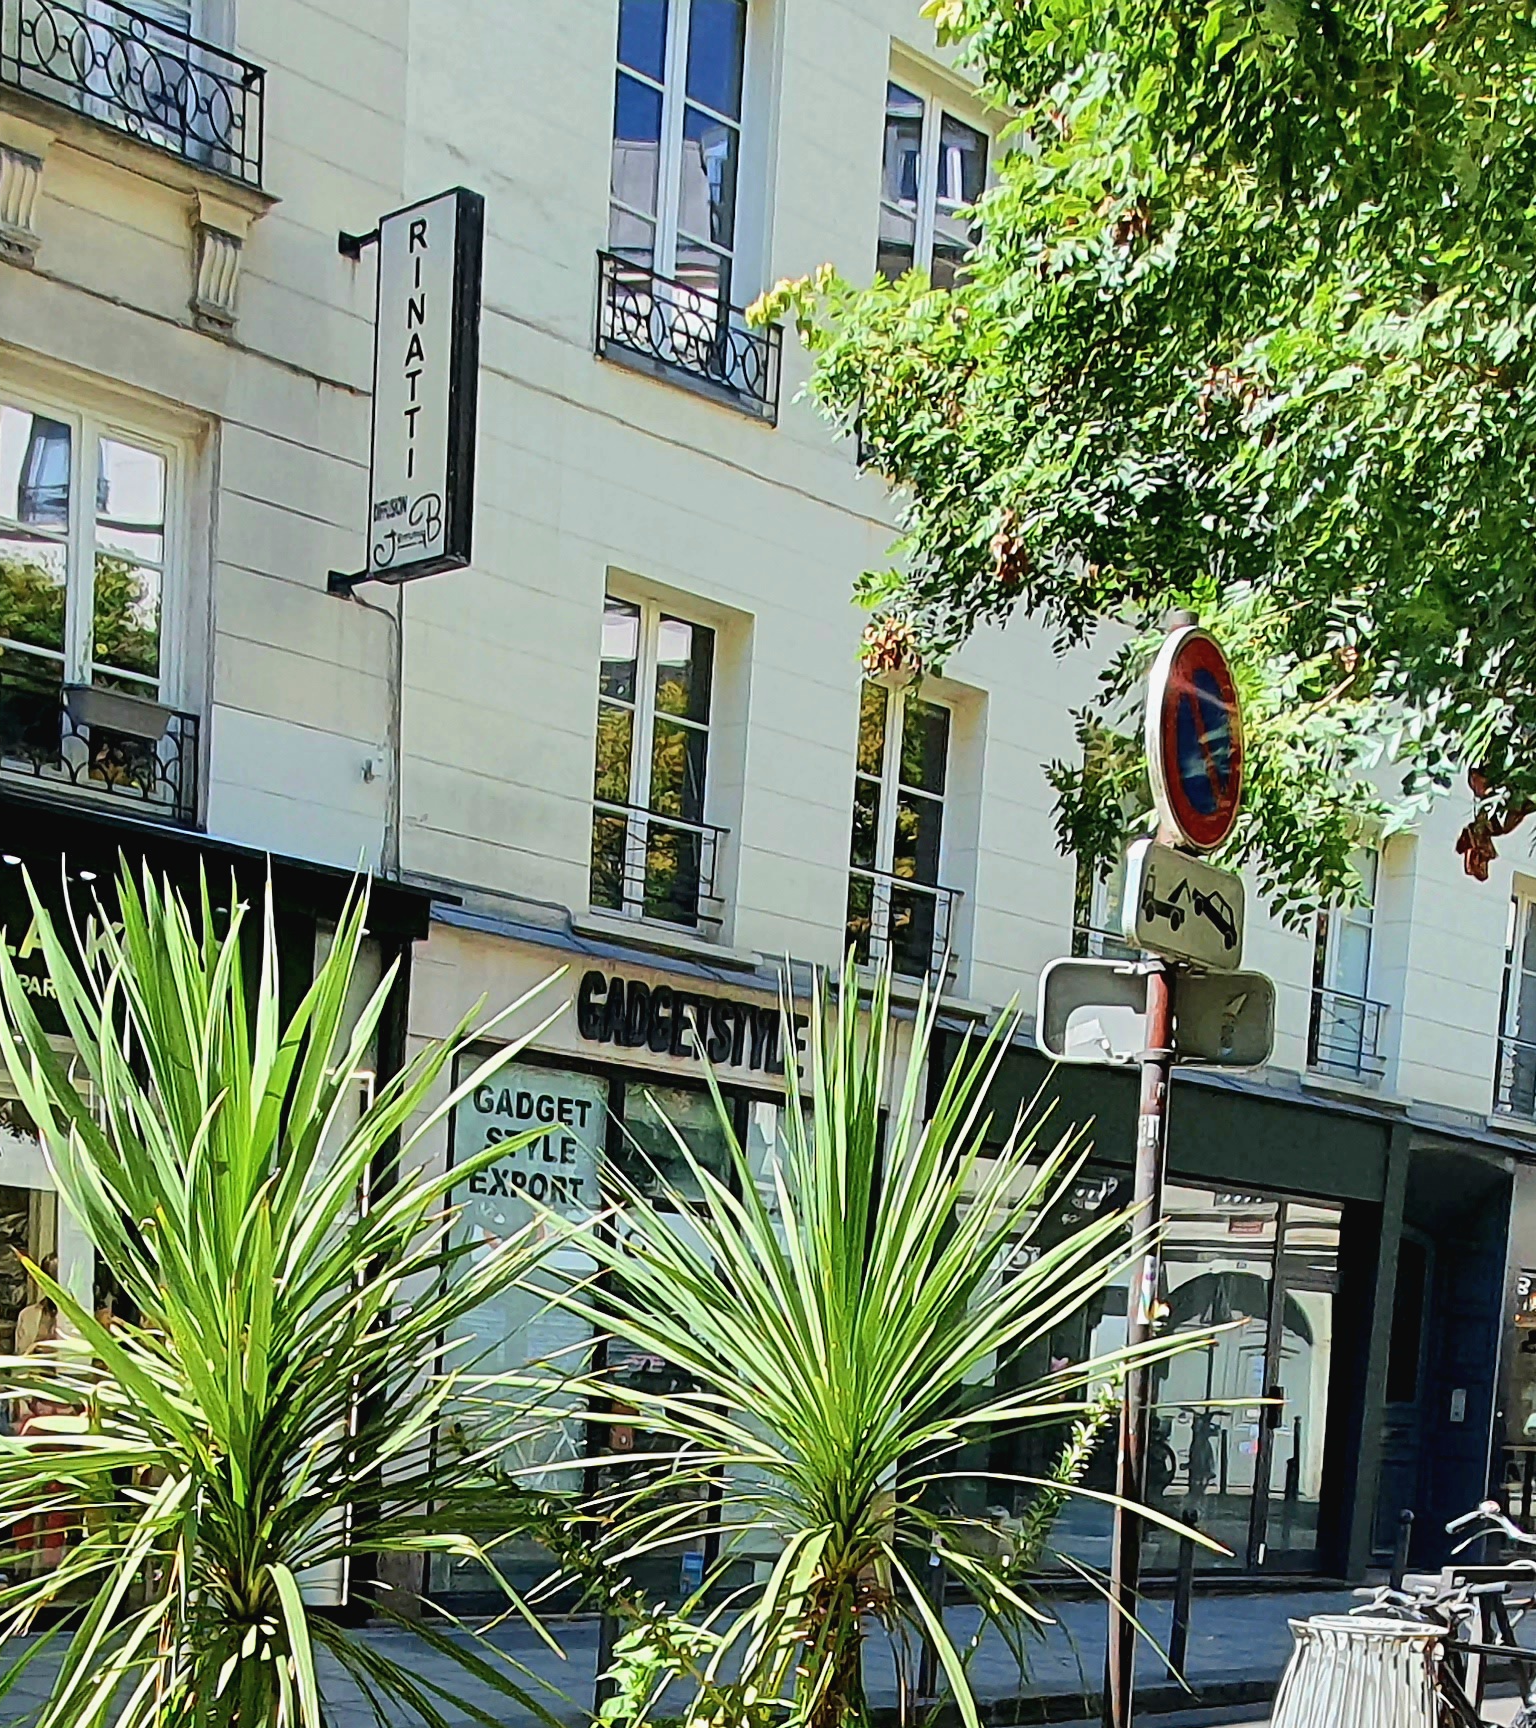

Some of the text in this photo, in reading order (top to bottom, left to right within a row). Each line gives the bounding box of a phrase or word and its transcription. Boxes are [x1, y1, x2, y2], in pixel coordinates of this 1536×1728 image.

[404, 219, 427, 479] RINATTI
[473, 1084, 592, 1128] GADGET
[469, 1166, 584, 1206] EXPORT
